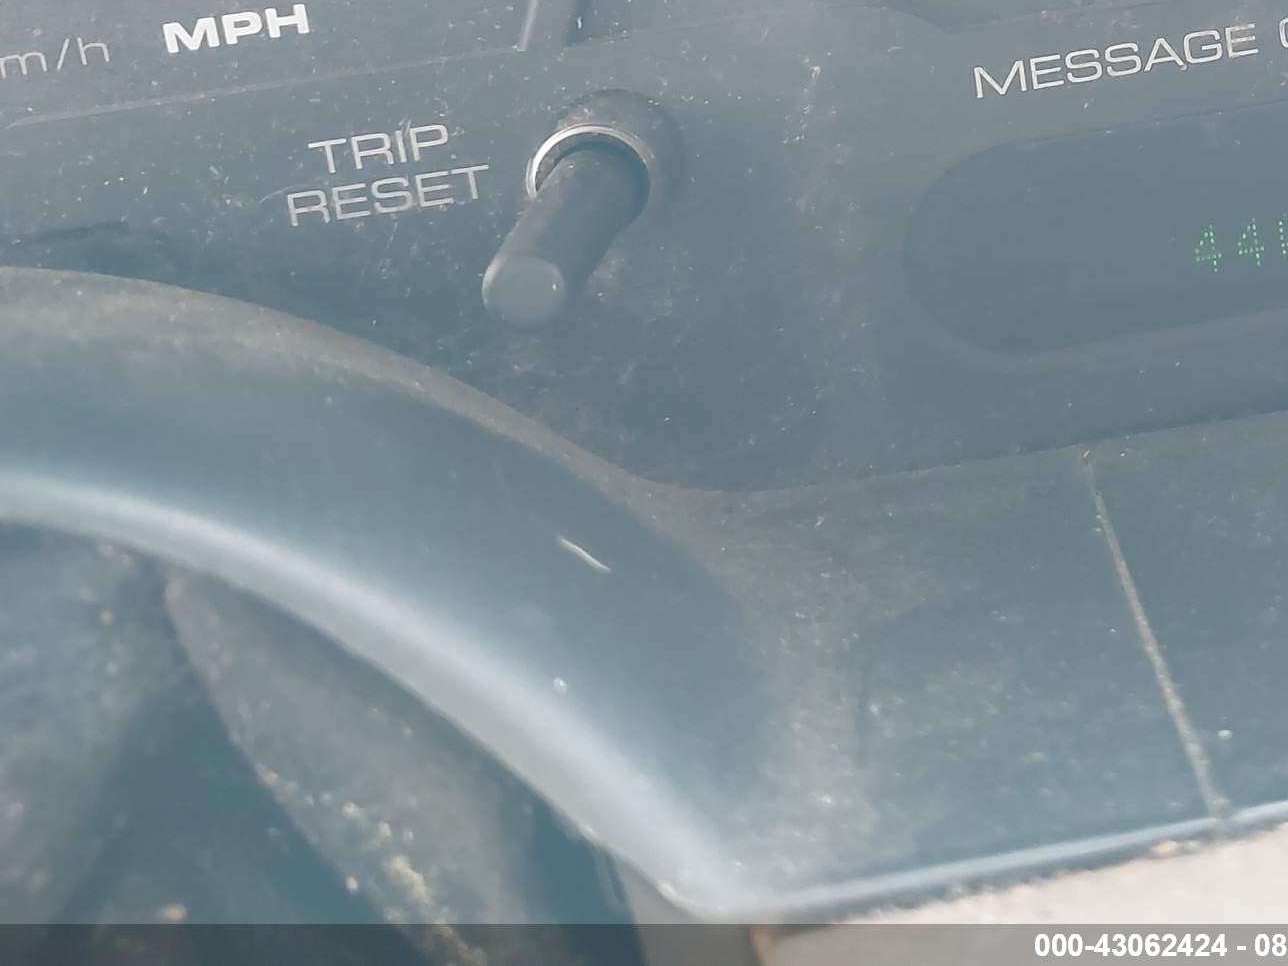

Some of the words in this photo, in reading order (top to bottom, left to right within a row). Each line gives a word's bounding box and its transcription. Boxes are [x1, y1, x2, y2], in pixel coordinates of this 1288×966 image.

[162, 3, 310, 54] MPH
[973, 23, 1259, 99] MESSAGE
[308, 123, 449, 174] TRIP
[287, 164, 489, 227] RESET
